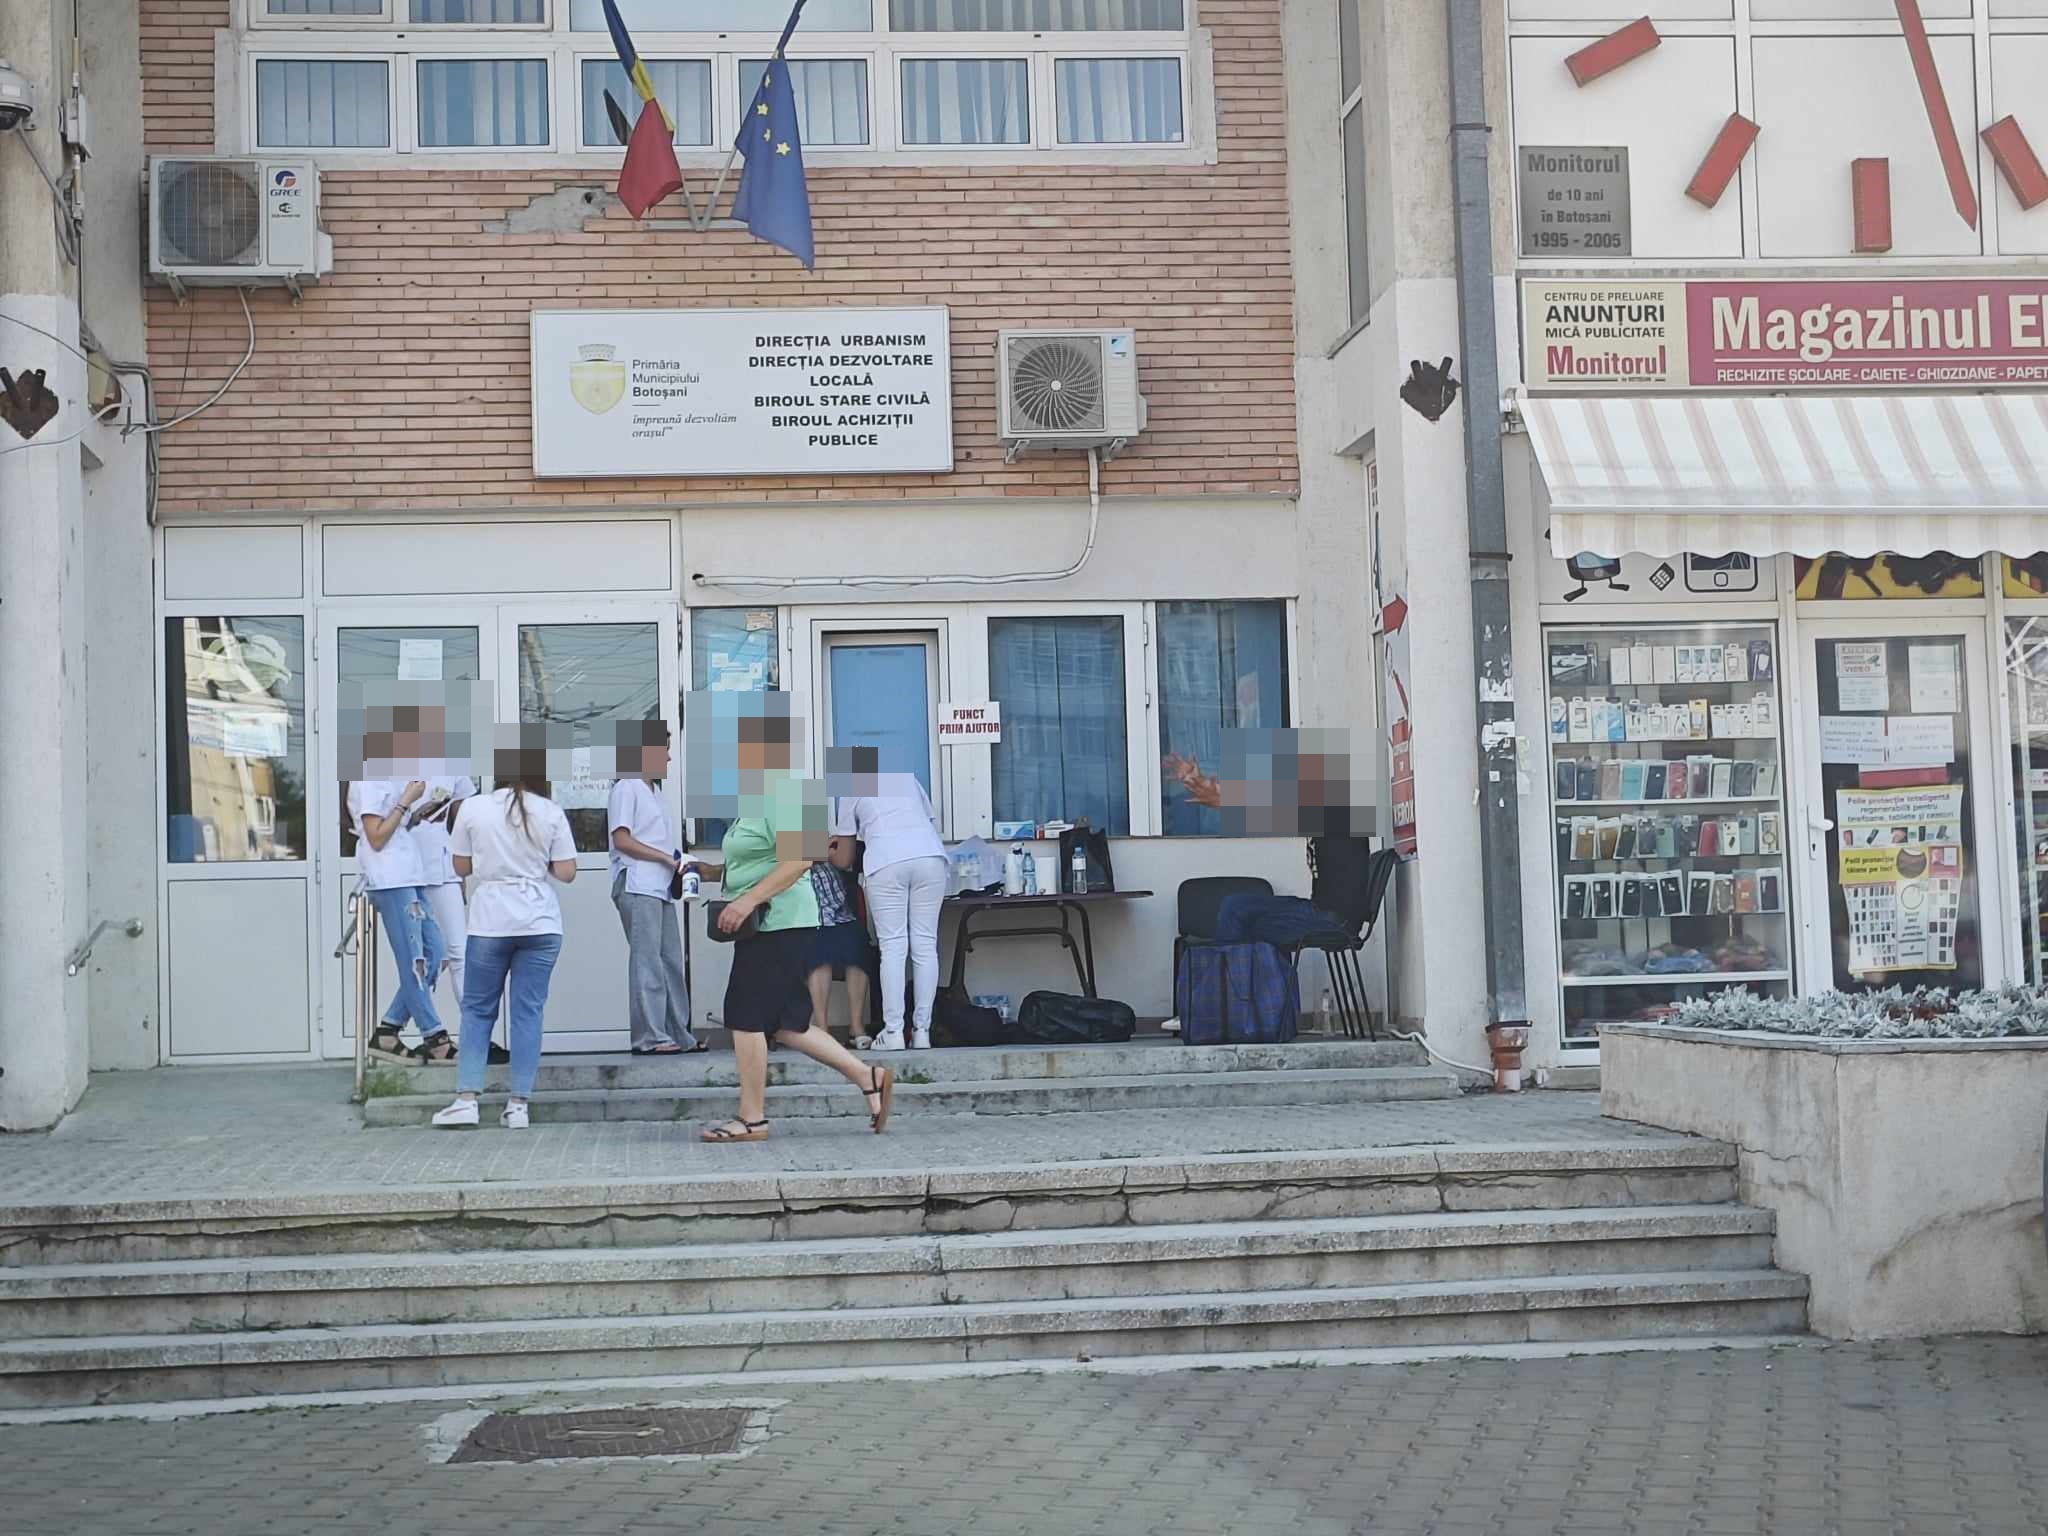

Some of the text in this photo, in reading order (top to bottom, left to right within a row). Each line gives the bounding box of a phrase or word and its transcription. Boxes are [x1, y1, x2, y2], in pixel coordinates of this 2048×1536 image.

[1528, 154, 1620, 173] Monitorul
[1547, 188, 1604, 201] de 10 ani
[1532, 232, 1568, 248] 1995
[1584, 232, 1621, 248] 2005
[1544, 291, 1664, 301] CENTRU DE PRELUARE
[1545, 304, 1664, 326] ANUNȚURI
[1545, 326, 1665, 338] MICĂ PUBLICITATE
[1712, 294, 2048, 363] Magazinul E
[755, 335, 926, 351] DIRECȚIA URBANISM
[749, 354, 933, 370] DIRECȚIA DEZVOLTARE
[1547, 345, 1667, 375] Monitorul
[632, 373, 700, 385] Municipiului
[810, 372, 873, 387] LOCALĂ
[1717, 368, 1786, 382] RECHIZITE
[1789, 367, 1850, 384] ȘCOLARE
[1861, 368, 1907, 380] CAIETE
[1917, 367, 1997, 380] GHIOZDANE
[754, 391, 930, 407] BIROUL STARE CIVILĂ
[772, 413, 913, 429] BIROUL ACHIZIȚII
[808, 434, 878, 446] PUBLICE
[953, 709, 984, 720] PUNCT
[939, 722, 1000, 734] PRIM AJUTOR
